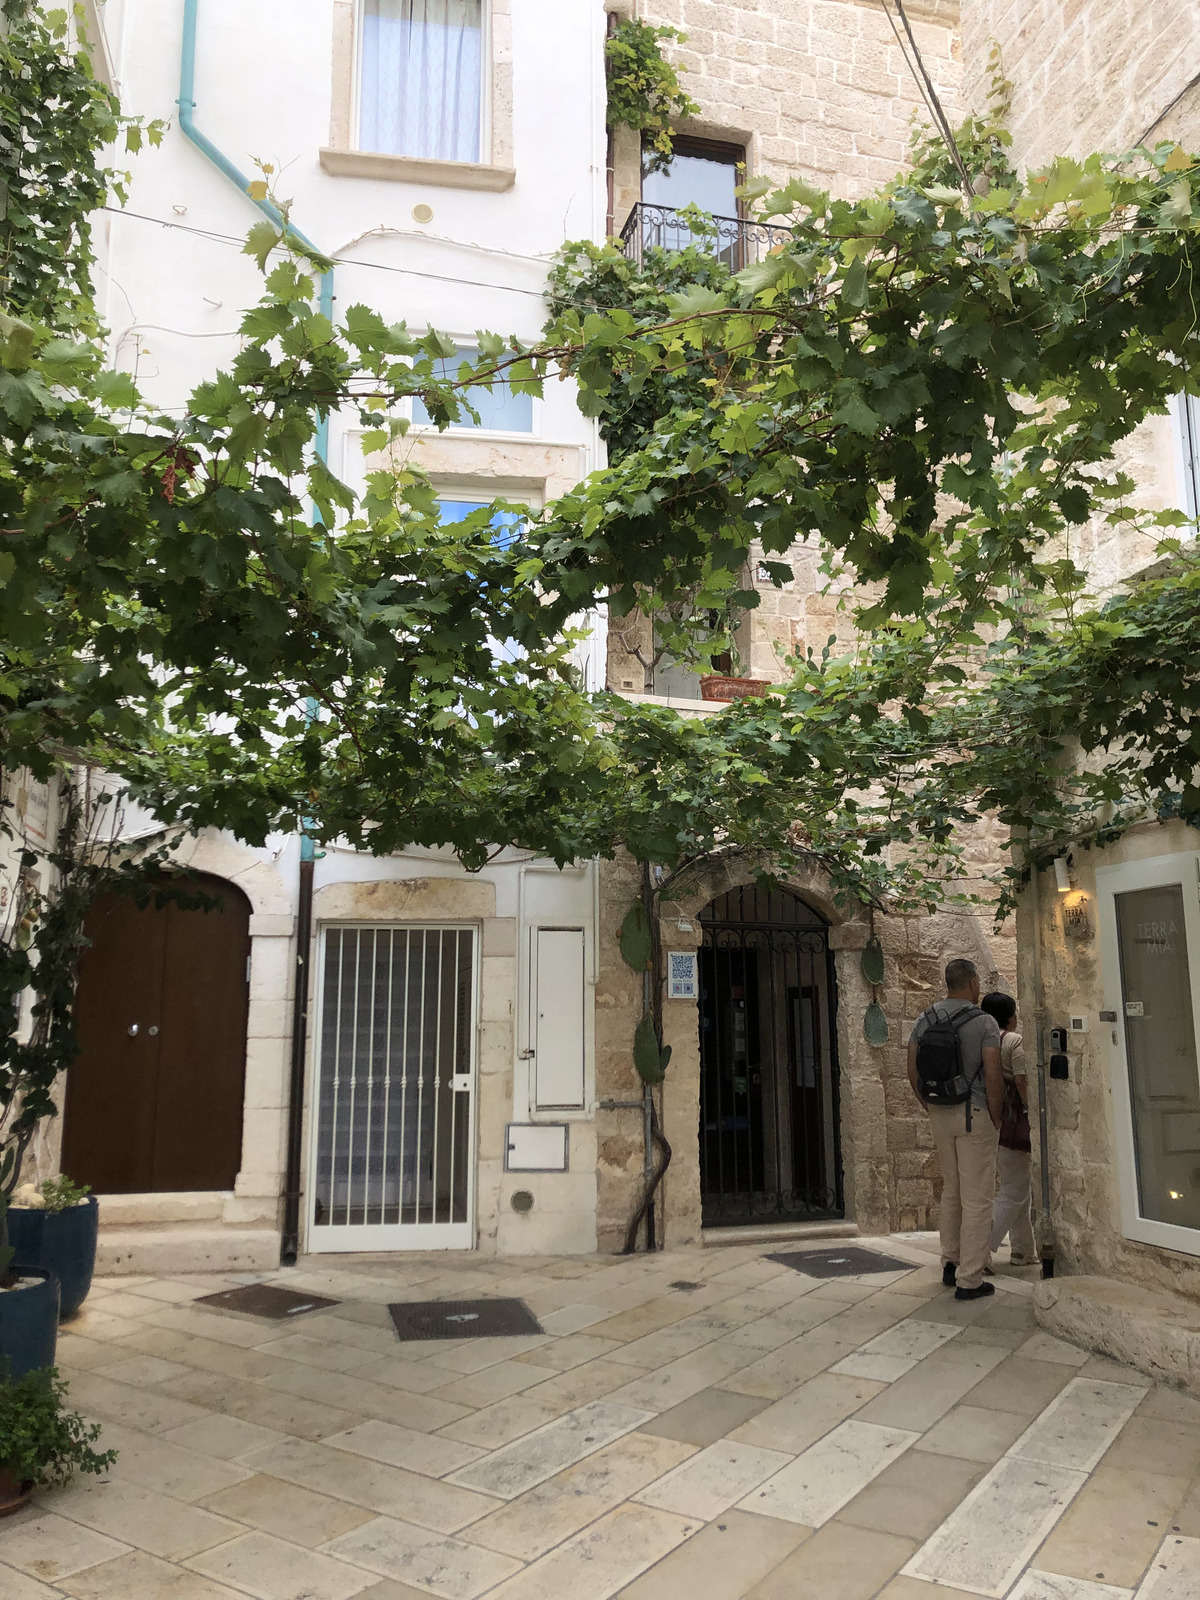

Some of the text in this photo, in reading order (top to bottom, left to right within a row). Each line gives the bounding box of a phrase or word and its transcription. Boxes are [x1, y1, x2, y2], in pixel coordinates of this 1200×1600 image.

[1065, 908, 1084, 918] TERRA
[1069, 917, 1081, 925] MIA
[1137, 920, 1178, 939] TERRA
[1147, 938, 1173, 954] MIA
